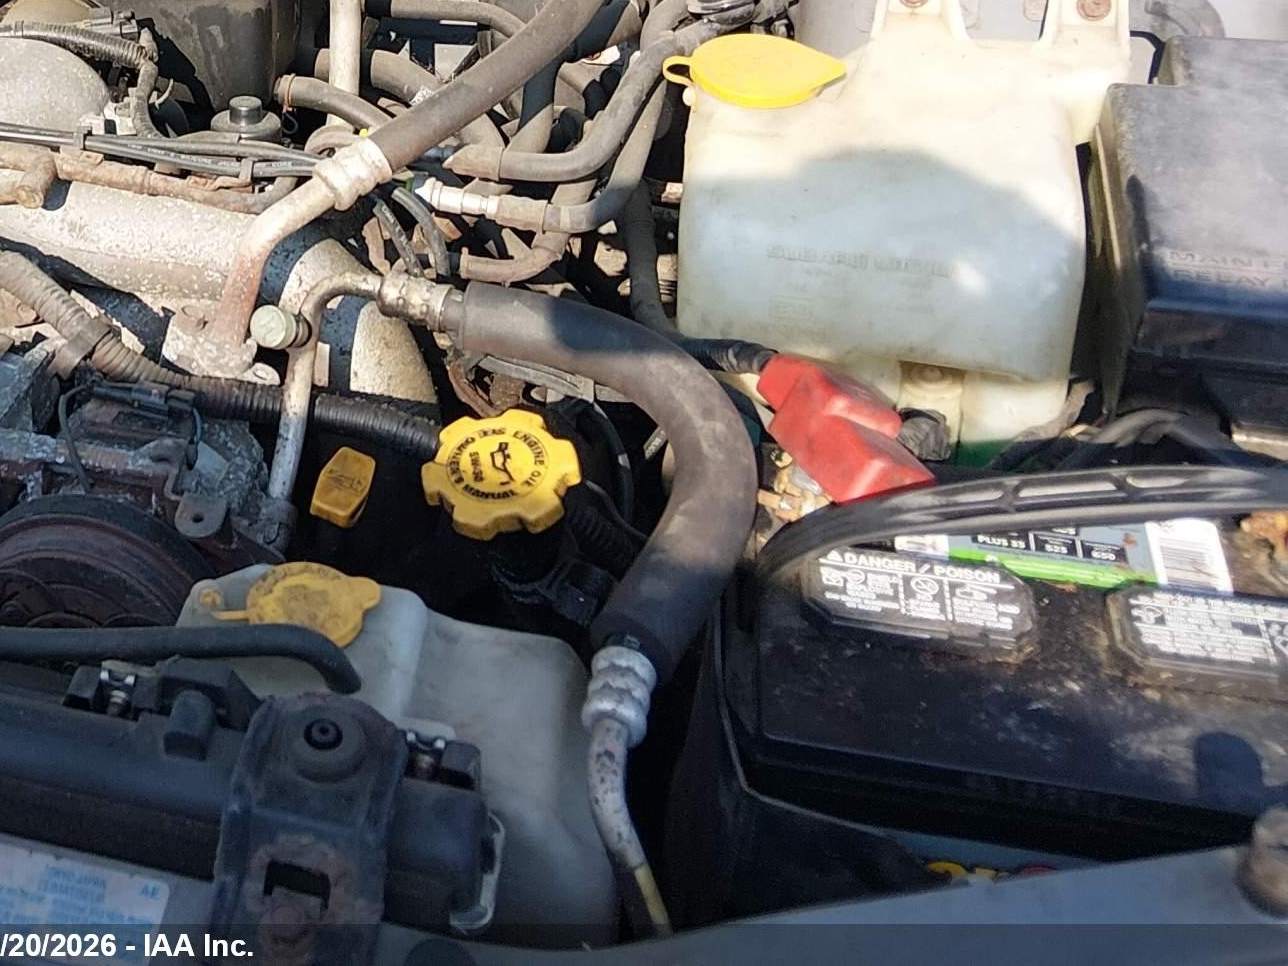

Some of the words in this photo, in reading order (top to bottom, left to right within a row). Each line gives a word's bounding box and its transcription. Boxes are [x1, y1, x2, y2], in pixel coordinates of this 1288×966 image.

[1173, 268, 1270, 286] RELAY
[512, 429, 546, 467] ENGINE
[521, 470, 542, 488] OIL
[462, 482, 519, 500] MANUAL
[977, 534, 1008, 548] PLUS
[844, 553, 916, 573] DANGER
[935, 567, 1000, 584] POISON
